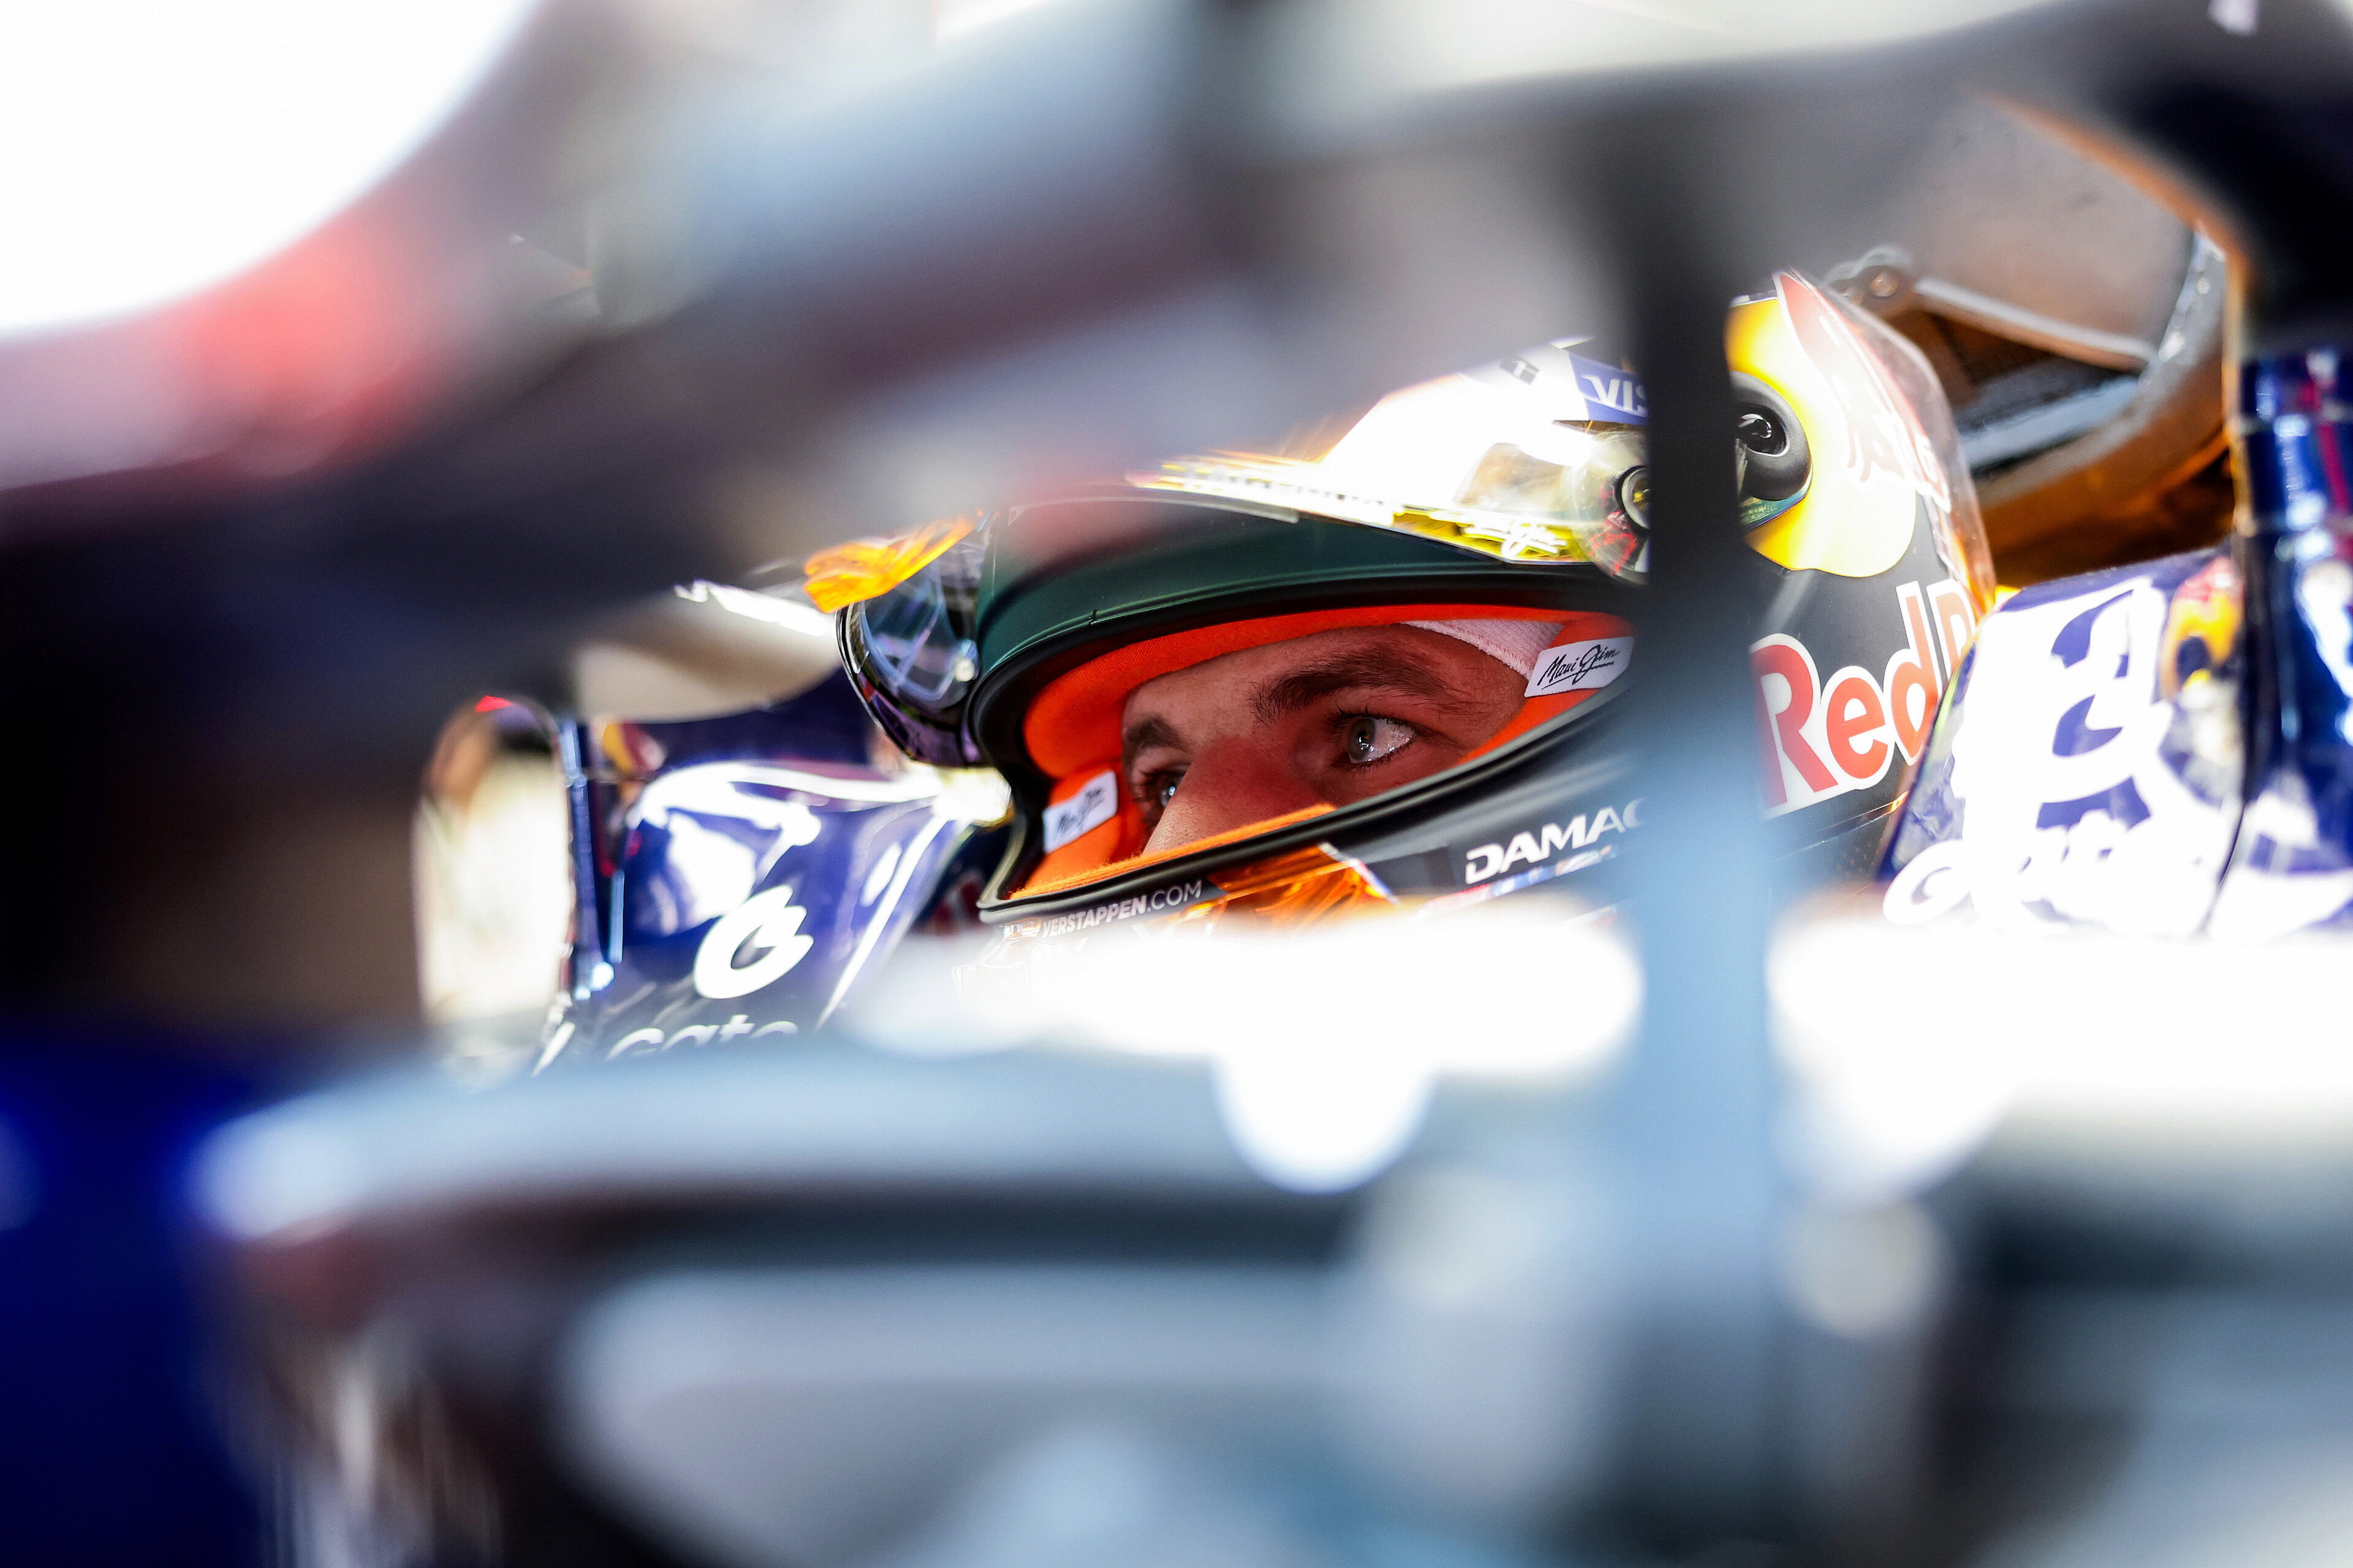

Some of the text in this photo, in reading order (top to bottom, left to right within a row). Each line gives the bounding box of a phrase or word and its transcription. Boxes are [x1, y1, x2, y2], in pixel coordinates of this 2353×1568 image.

[1580, 374, 1648, 417] VIS
[1537, 644, 1620, 686] Maui Jim
[1749, 581, 1942, 820] Red
[1464, 798, 1646, 885] DAMAC
[1042, 880, 1203, 938] VERSTAPPEN.COM
